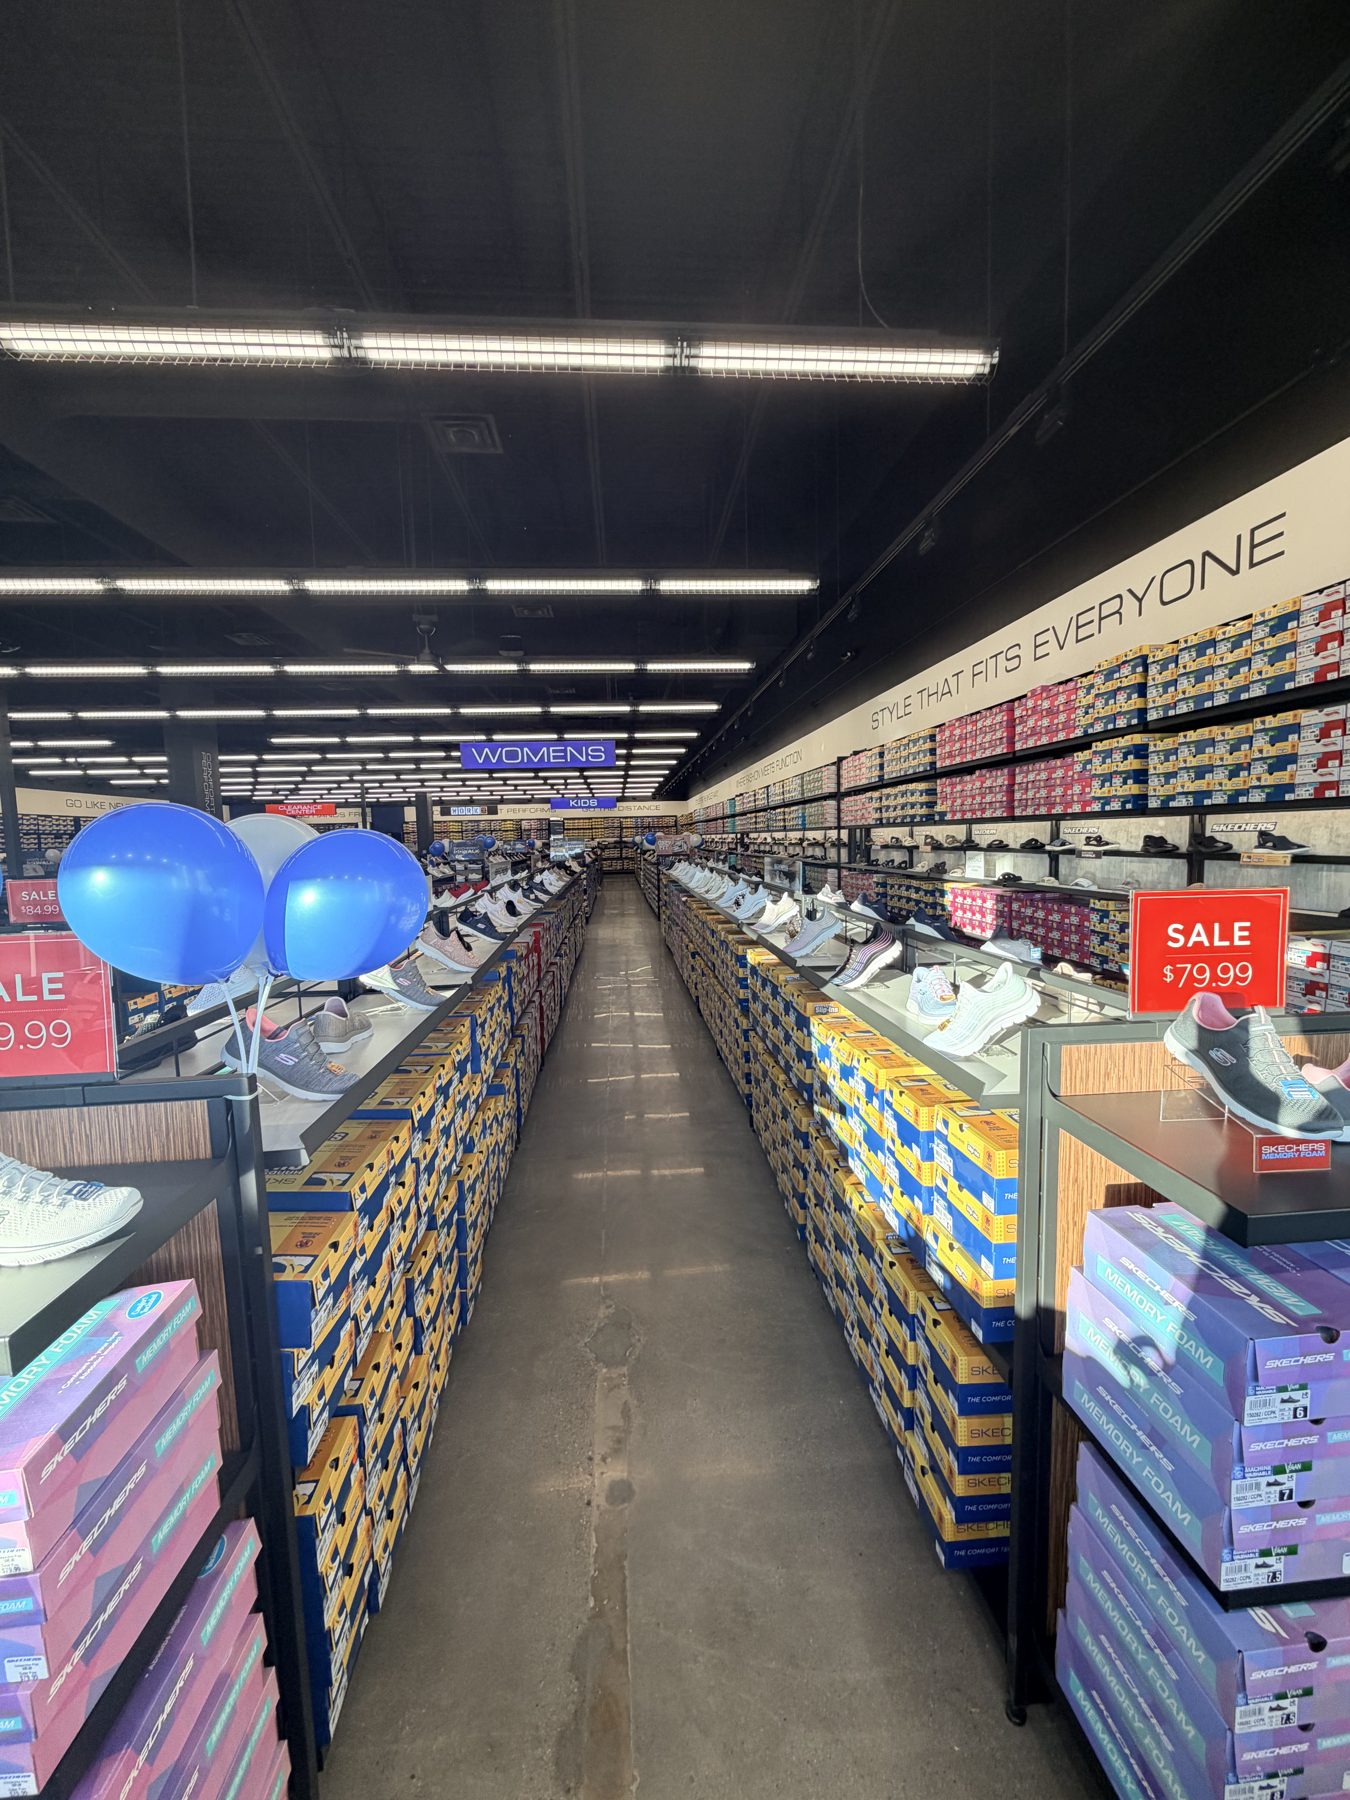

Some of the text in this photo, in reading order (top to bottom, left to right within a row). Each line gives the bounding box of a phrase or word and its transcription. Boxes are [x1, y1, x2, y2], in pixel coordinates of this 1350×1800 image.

[871, 512, 1287, 731] STYLE THAT FITS EVERYONE
[471, 745, 606, 764] WOMENS
[65, 798, 82, 808] GO
[85, 800, 106, 810] LIKE
[450, 806, 480, 815] WORK
[569, 799, 597, 807] KIDS
[617, 804, 661, 812] DISTANCE
[1063, 825, 1100, 835] SKECHERS
[1211, 821, 1277, 833] SKECHERS
[21, 890, 57, 901] SALE
[21, 904, 59, 915] $84.99
[1167, 921, 1252, 948] SALE
[1163, 961, 1253, 989] $79.99
[1261, 1142, 1326, 1154] SKECHERS
[1261, 1150, 1326, 1161] MEMORY FOAM
[1004, 1192, 1018, 1200] THE
[1002, 1256, 1017, 1265] THE
[1126, 1211, 1299, 1328] SKECHERS
[1119, 1256, 1198, 1322] SKECHERS
[991, 1320, 1006, 1328] THE
[1104, 1267, 1214, 1370] MEMORY FOAM
[50, 1309, 102, 1354] FOAM
[140, 1324, 173, 1366] MEMORY
[172, 1301, 196, 1330] FOAM
[1102, 1316, 1185, 1397] SKECHERS
[1265, 1352, 1336, 1369] SKECHERS
[1087, 1326, 1201, 1450] MEMORY FOAM
[160, 1375, 215, 1450] MEMORY FOAM
[1296, 1407, 1304, 1418] 6
[39, 1373, 129, 1485] SKECHERS
[970, 1427, 1012, 1439] SKEC
[1095, 1385, 1175, 1473] SKECHERS
[1248, 1435, 1320, 1452] SKECHERS
[1081, 1393, 1192, 1527] MEMORY FOAM
[156, 1459, 216, 1546] MEMORY FOAM
[1282, 1489, 1290, 1500] 7
[964, 1504, 977, 1512] THE
[57, 1458, 148, 1589] SKECHERS
[1237, 1516, 1309, 1534] SKECHERS
[1109, 1504, 1189, 1607] SKECHERS
[1095, 1507, 1206, 1665] MEMORY FOAM
[1267, 1570, 1282, 1583] 7.5
[47, 1556, 144, 1705] SKECHERS
[1101, 1569, 1179, 1681] SKECHERS
[1086, 1572, 1195, 1740] MEMORY FOAM
[1250, 1661, 1318, 1680] SKECHERS
[1084, 1635, 1143, 1731] MEMORY
[1099, 1634, 1175, 1752] SKECHERS
[1281, 1712, 1296, 1725] 7.5
[1077, 1689, 1137, 1792] MEMORY
[1241, 1742, 1310, 1760] SKECHERS
